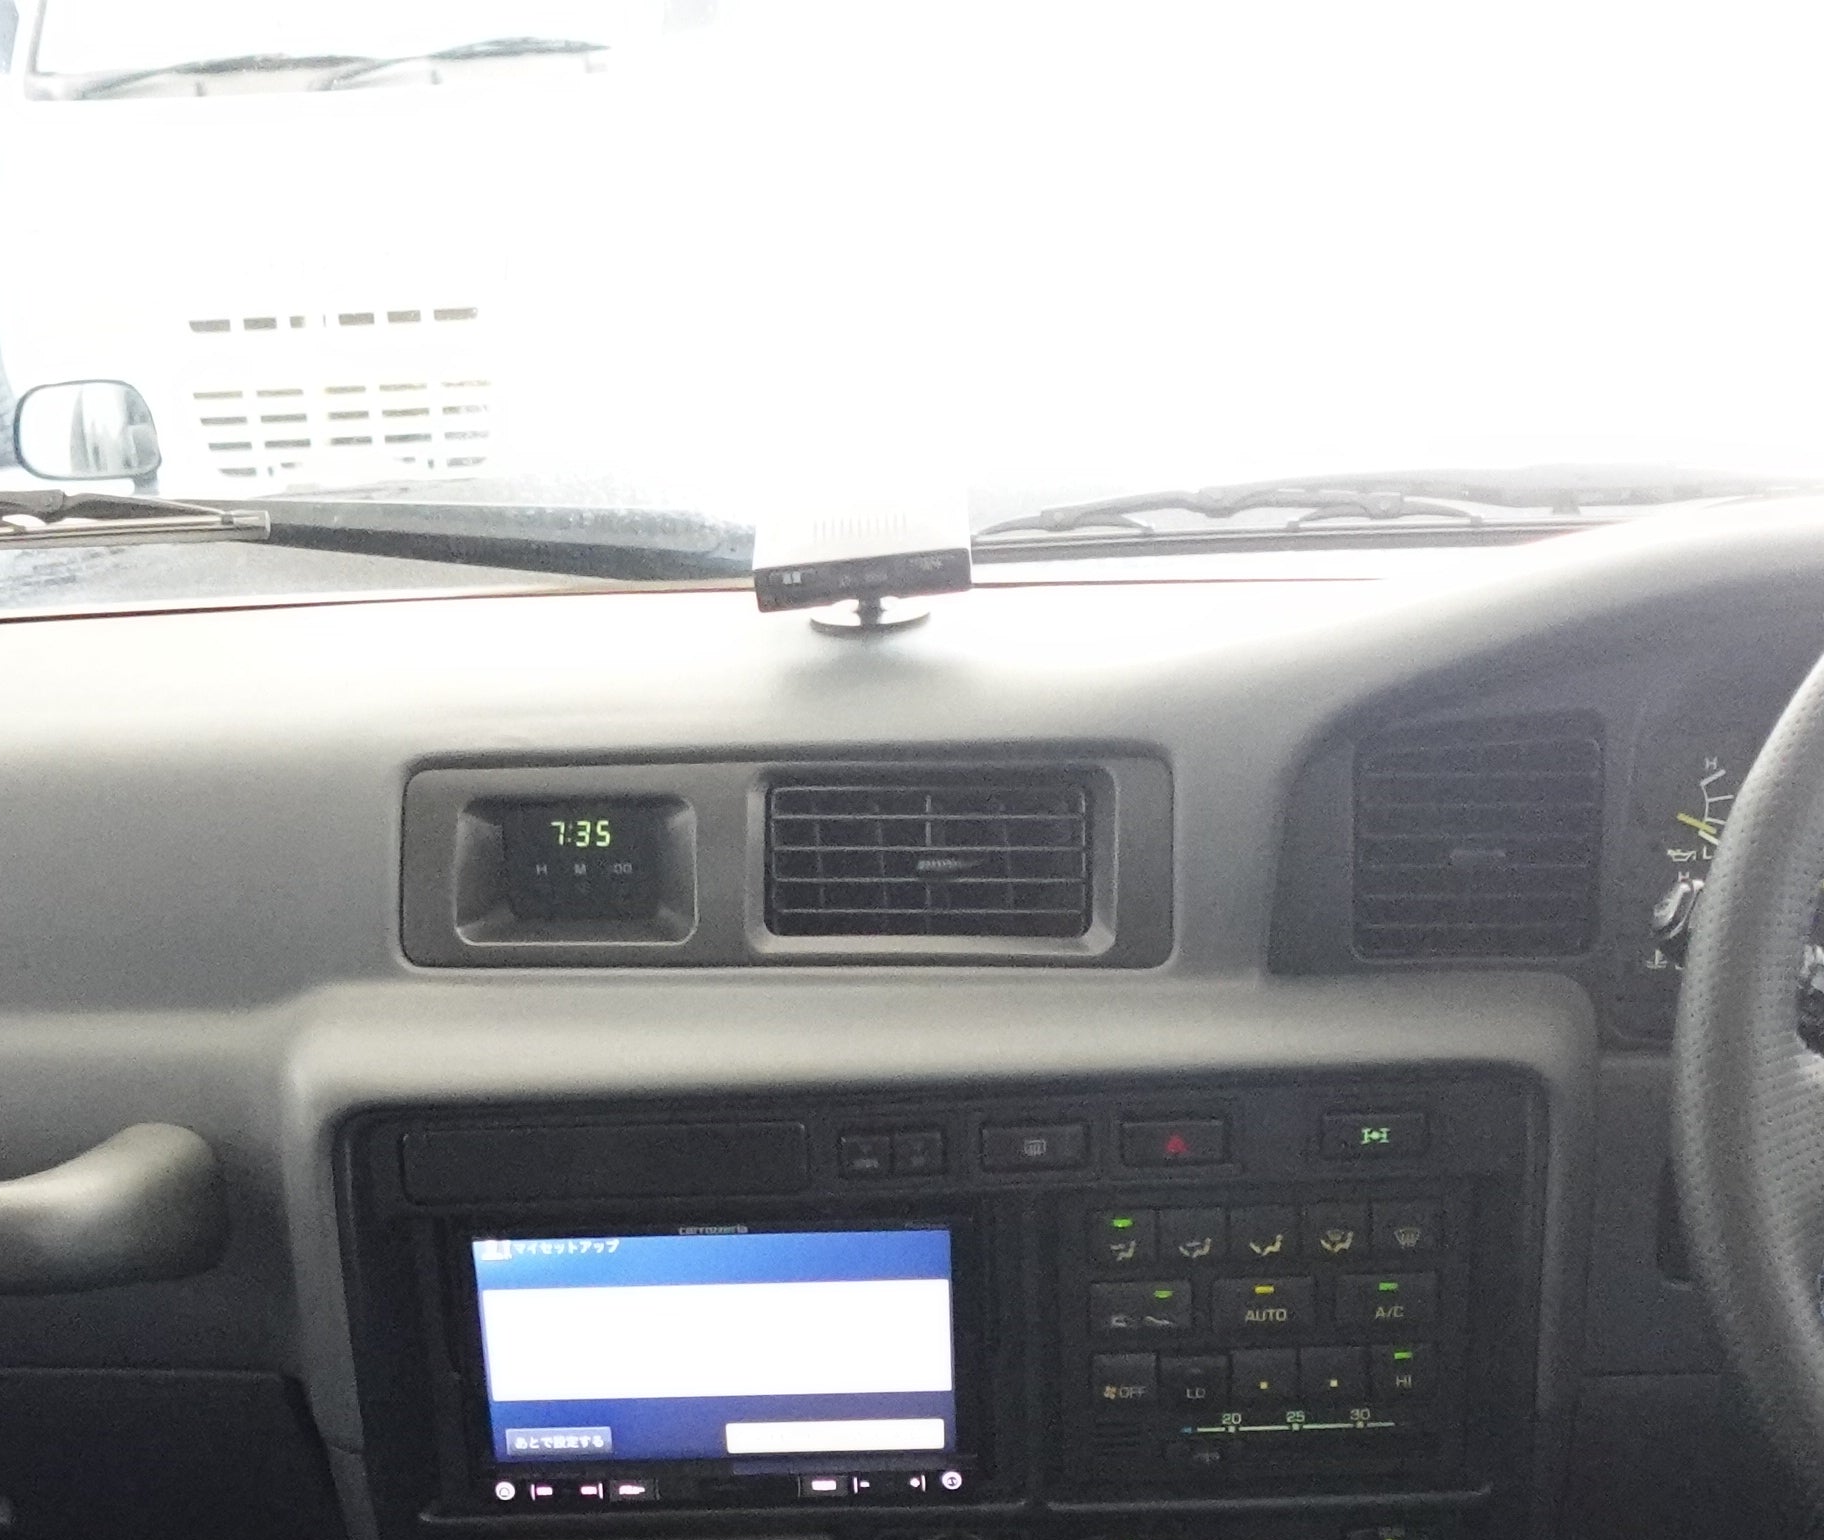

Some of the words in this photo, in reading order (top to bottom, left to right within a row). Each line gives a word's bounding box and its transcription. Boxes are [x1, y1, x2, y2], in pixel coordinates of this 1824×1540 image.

[1705, 757, 1718, 770] H
[551, 820, 611, 847] 7:35
[536, 864, 547, 875] H
[575, 863, 587, 874] M
[513, 1239, 620, 1255] マイセットアップ
[1245, 1308, 1287, 1322] AUTO
[1376, 1305, 1404, 1320] A/C
[1396, 1376, 1413, 1389] HI
[1120, 1387, 1146, 1400] OFF
[1186, 1388, 1206, 1400] LO
[1222, 1413, 1242, 1426] 20
[1286, 1411, 1306, 1423] 25
[1350, 1408, 1370, 1421] 30
[515, 1435, 604, 1450] あとで設定する
